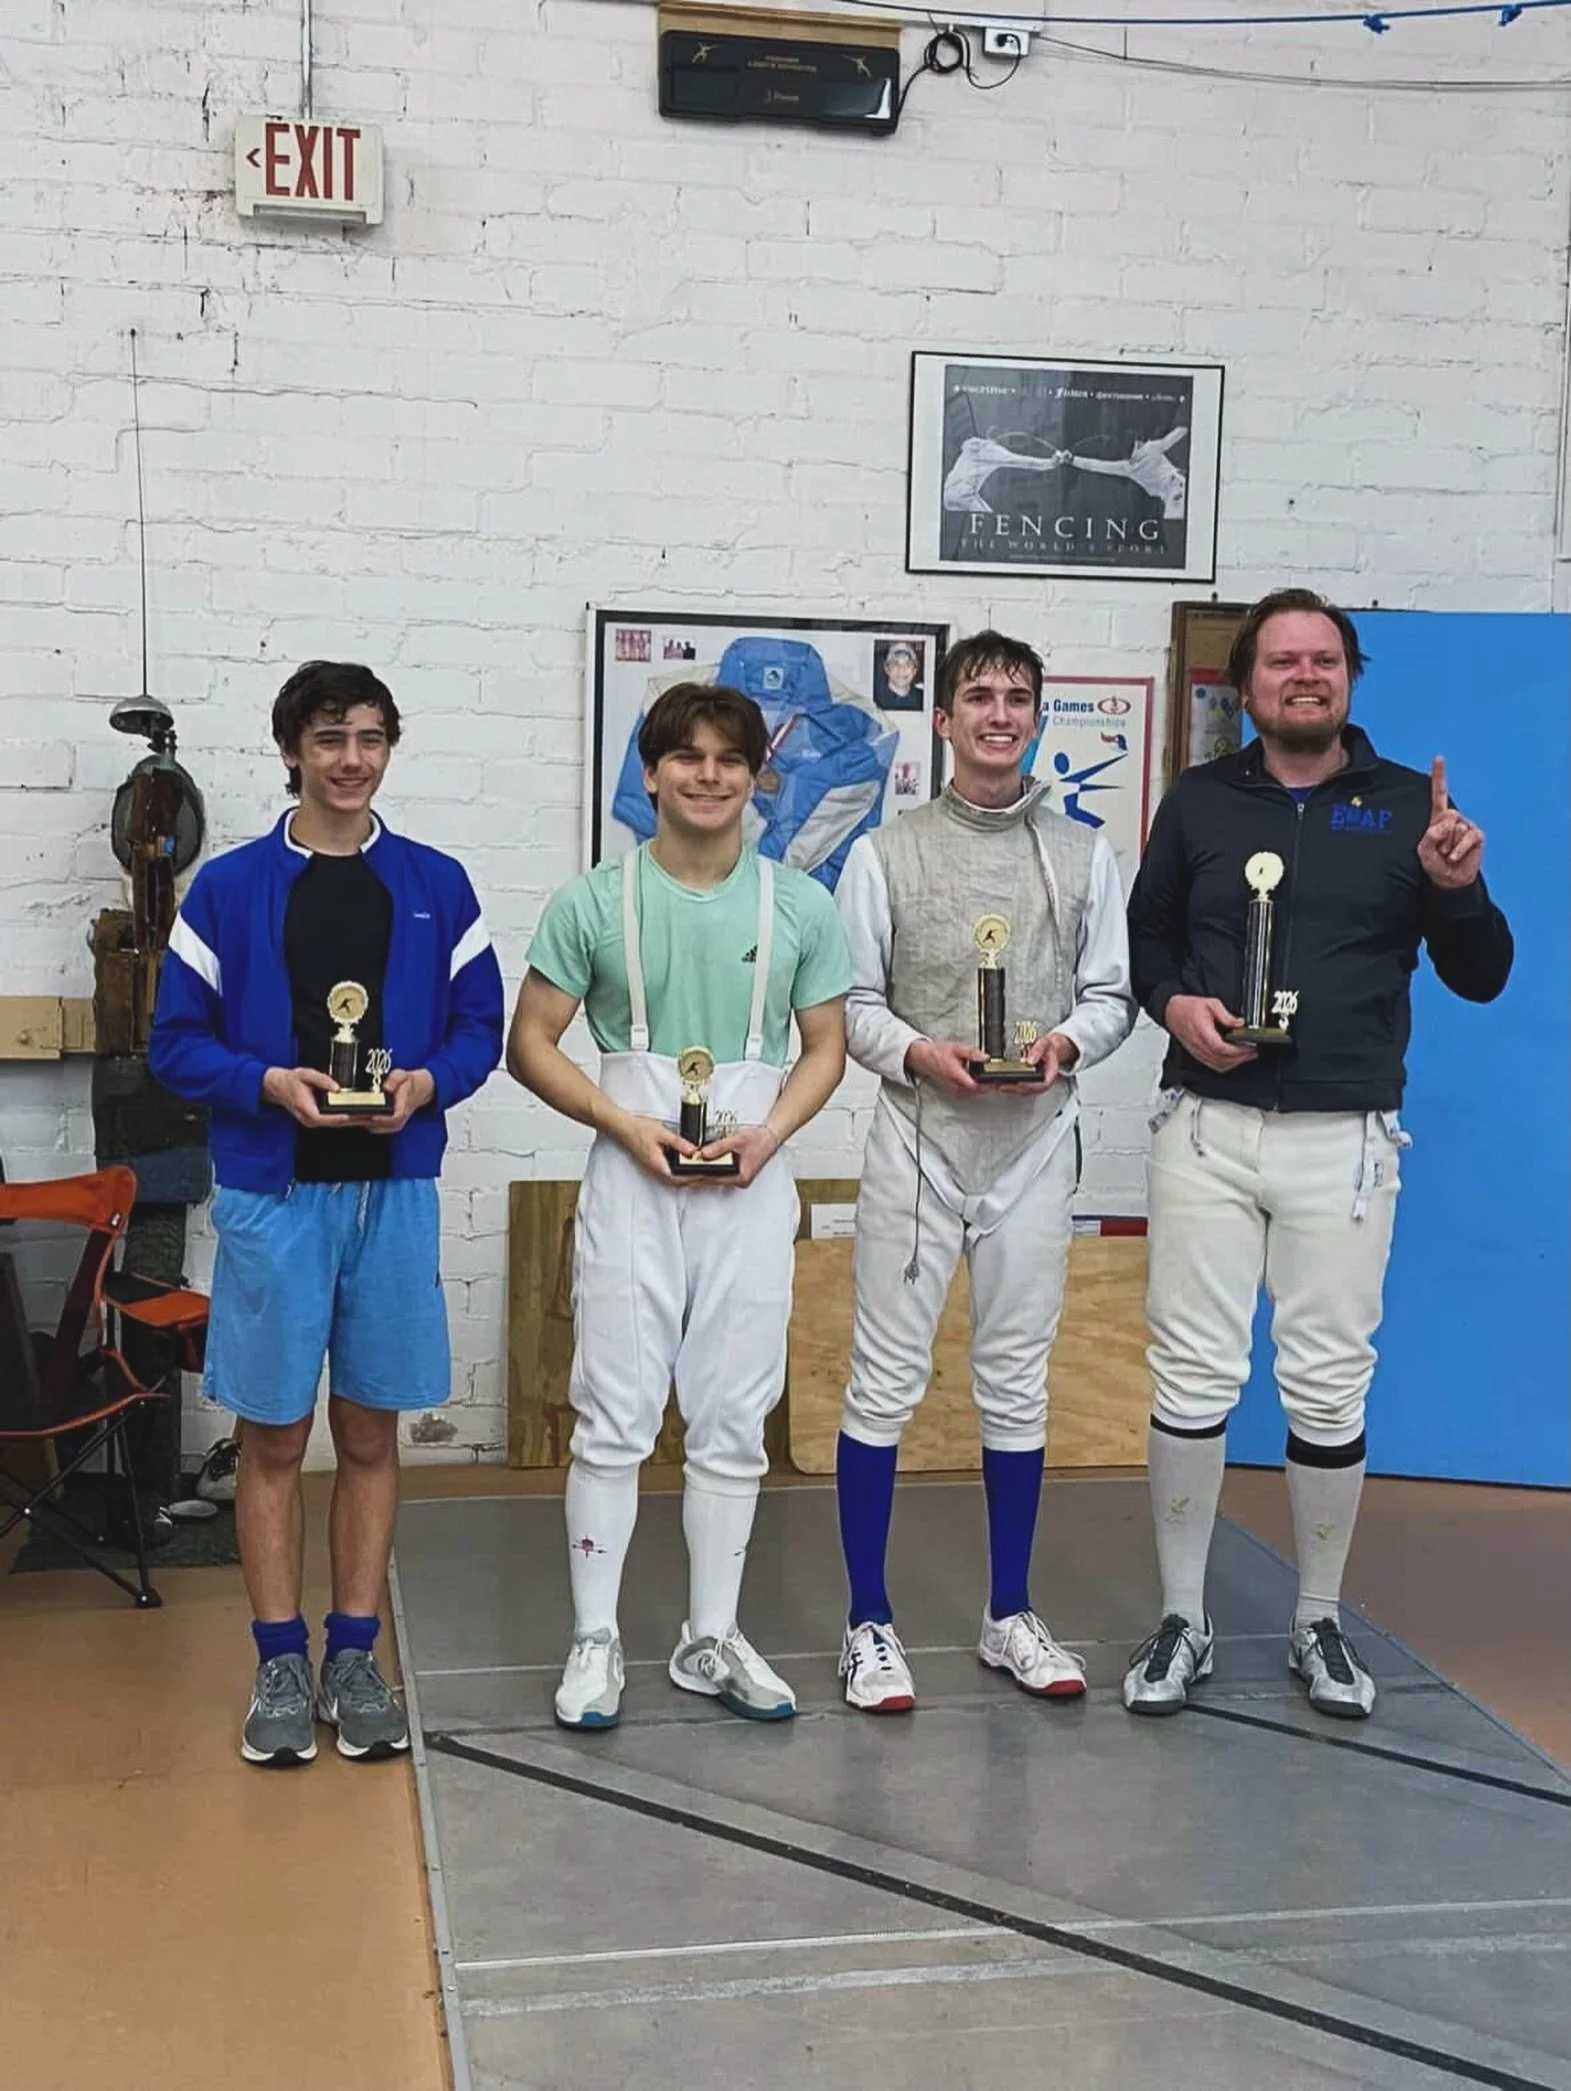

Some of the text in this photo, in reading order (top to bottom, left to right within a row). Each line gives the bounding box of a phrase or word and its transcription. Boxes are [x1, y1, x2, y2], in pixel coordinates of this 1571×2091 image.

[265, 122, 361, 201] EXIT
[970, 513, 1159, 541] FENCING
[1008, 540, 1096, 553] WORLDS
[1053, 699, 1094, 713] Games
